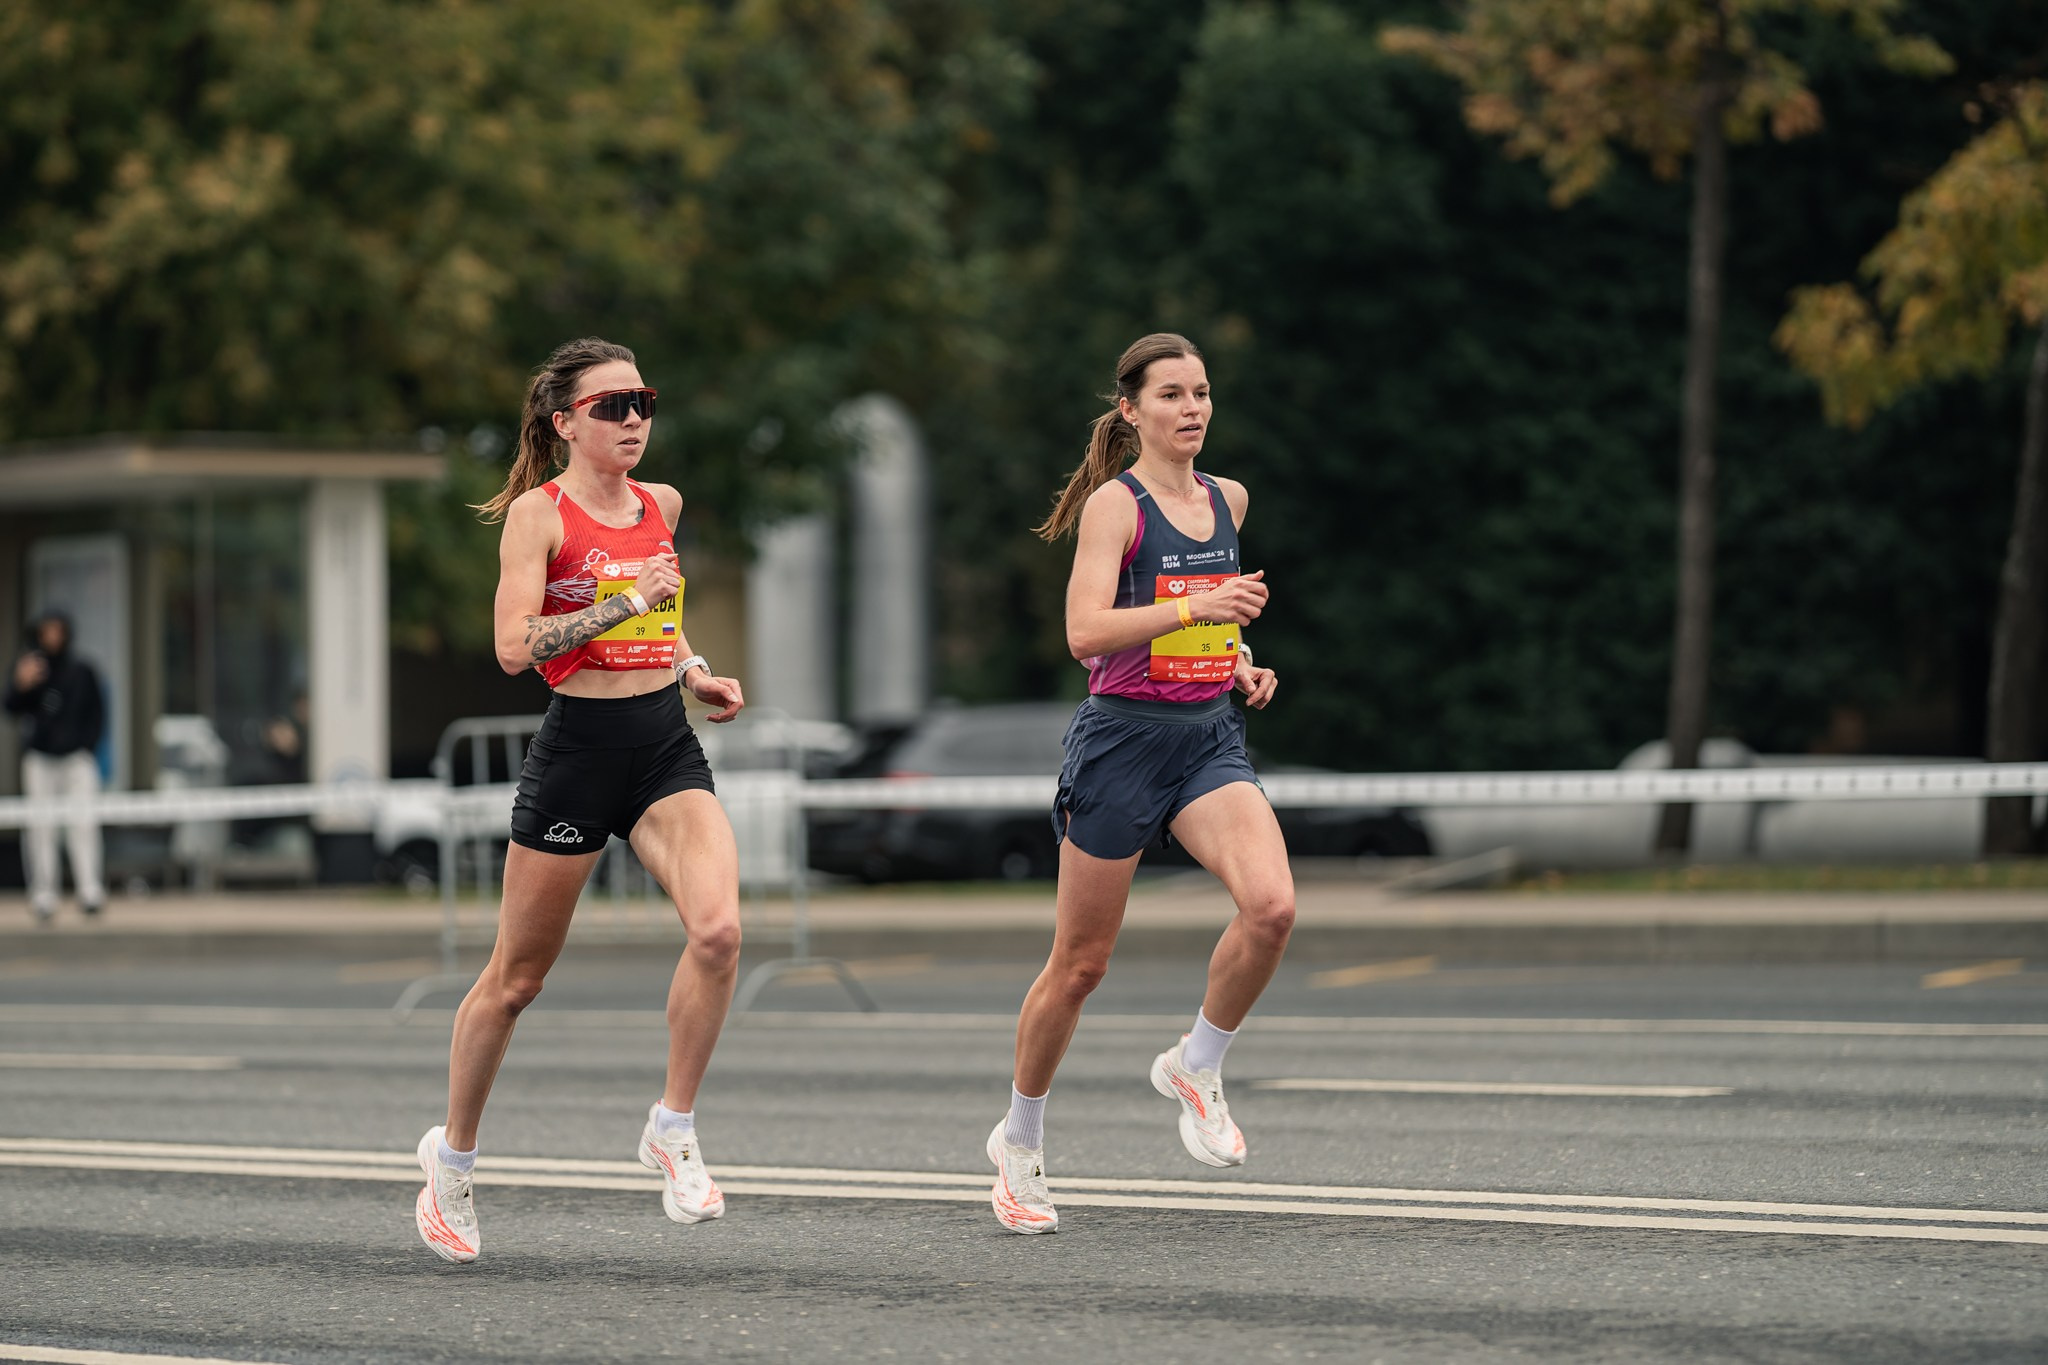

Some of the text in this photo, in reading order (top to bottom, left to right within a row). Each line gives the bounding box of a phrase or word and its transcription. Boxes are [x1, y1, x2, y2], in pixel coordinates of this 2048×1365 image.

[1162, 554, 1179, 562] BIV
[1163, 561, 1181, 569] IUM
[636, 627, 645, 635] 39
[1201, 643, 1210, 652] 35
[543, 834, 575, 843] CLOUD
